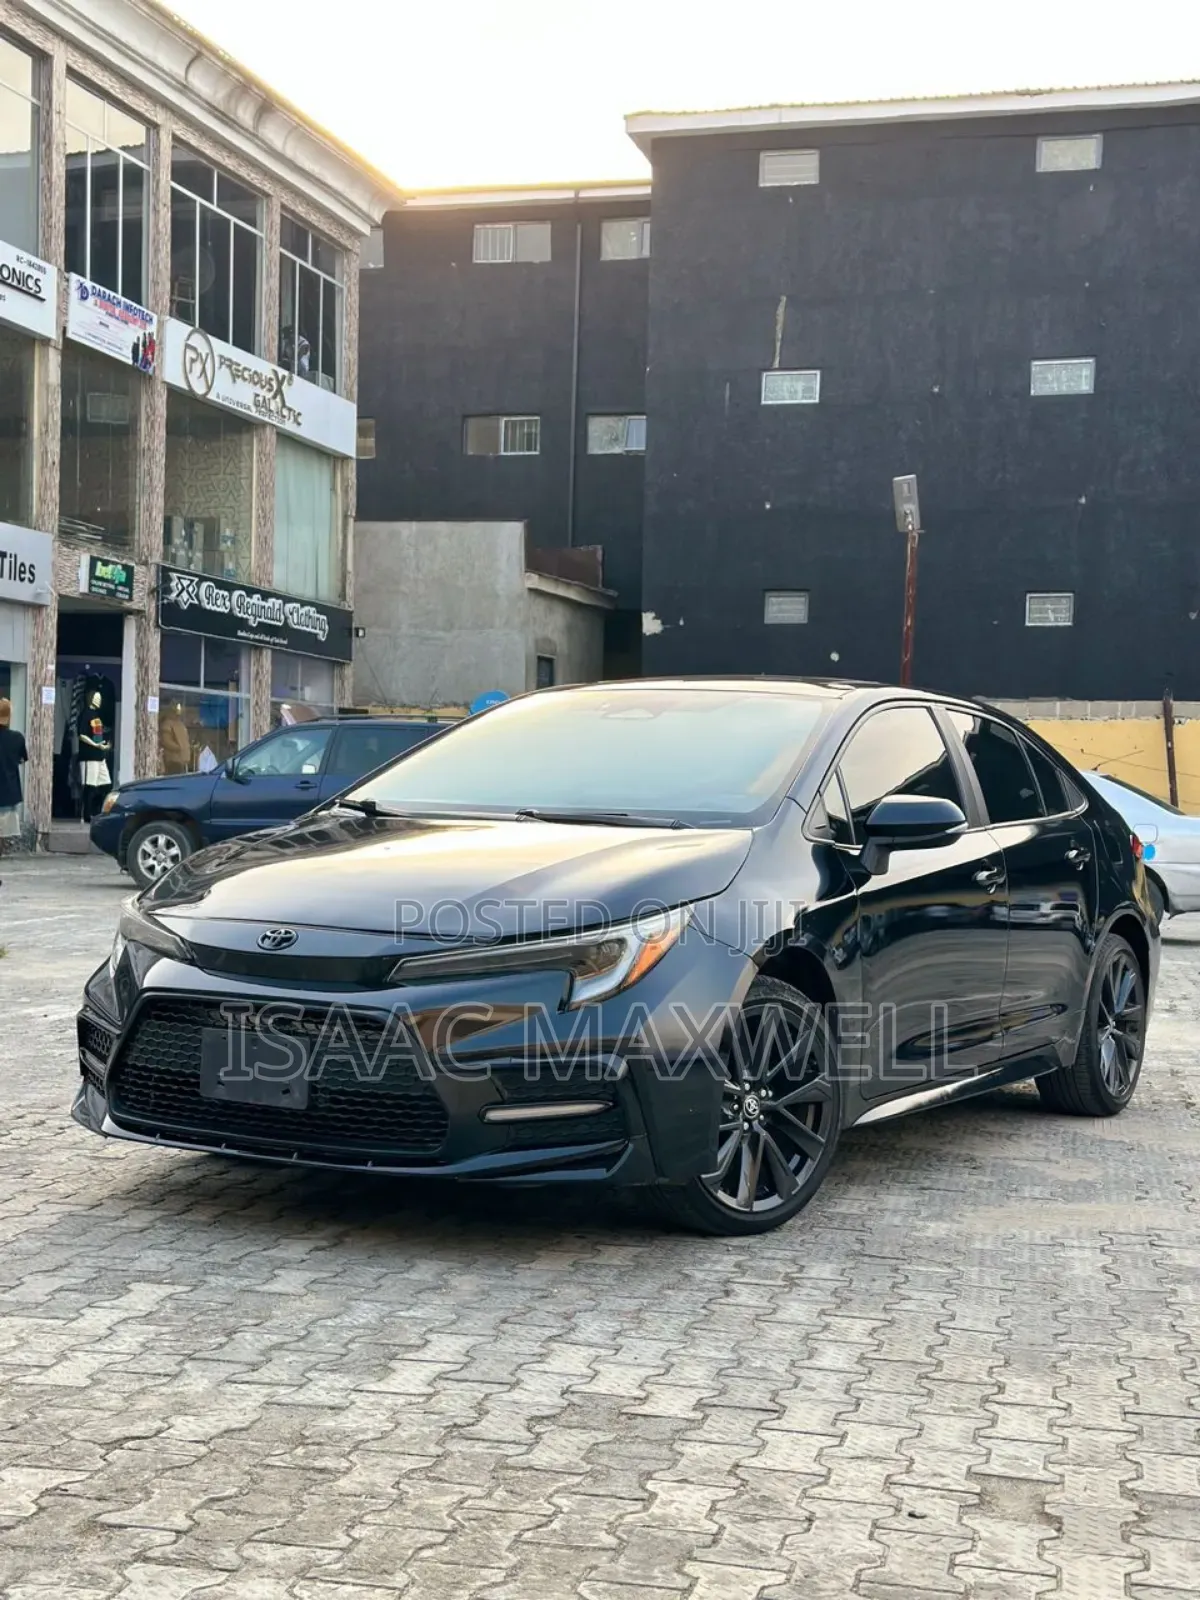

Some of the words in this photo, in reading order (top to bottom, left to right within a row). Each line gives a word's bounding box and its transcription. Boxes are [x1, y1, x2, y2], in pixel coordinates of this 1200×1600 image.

[0, 263, 42, 295] ONICS
[0, 550, 36, 584] Tiles
[200, 578, 230, 614] Rex
[231, 590, 285, 627] Reginald
[284, 602, 329, 642] Clothing
